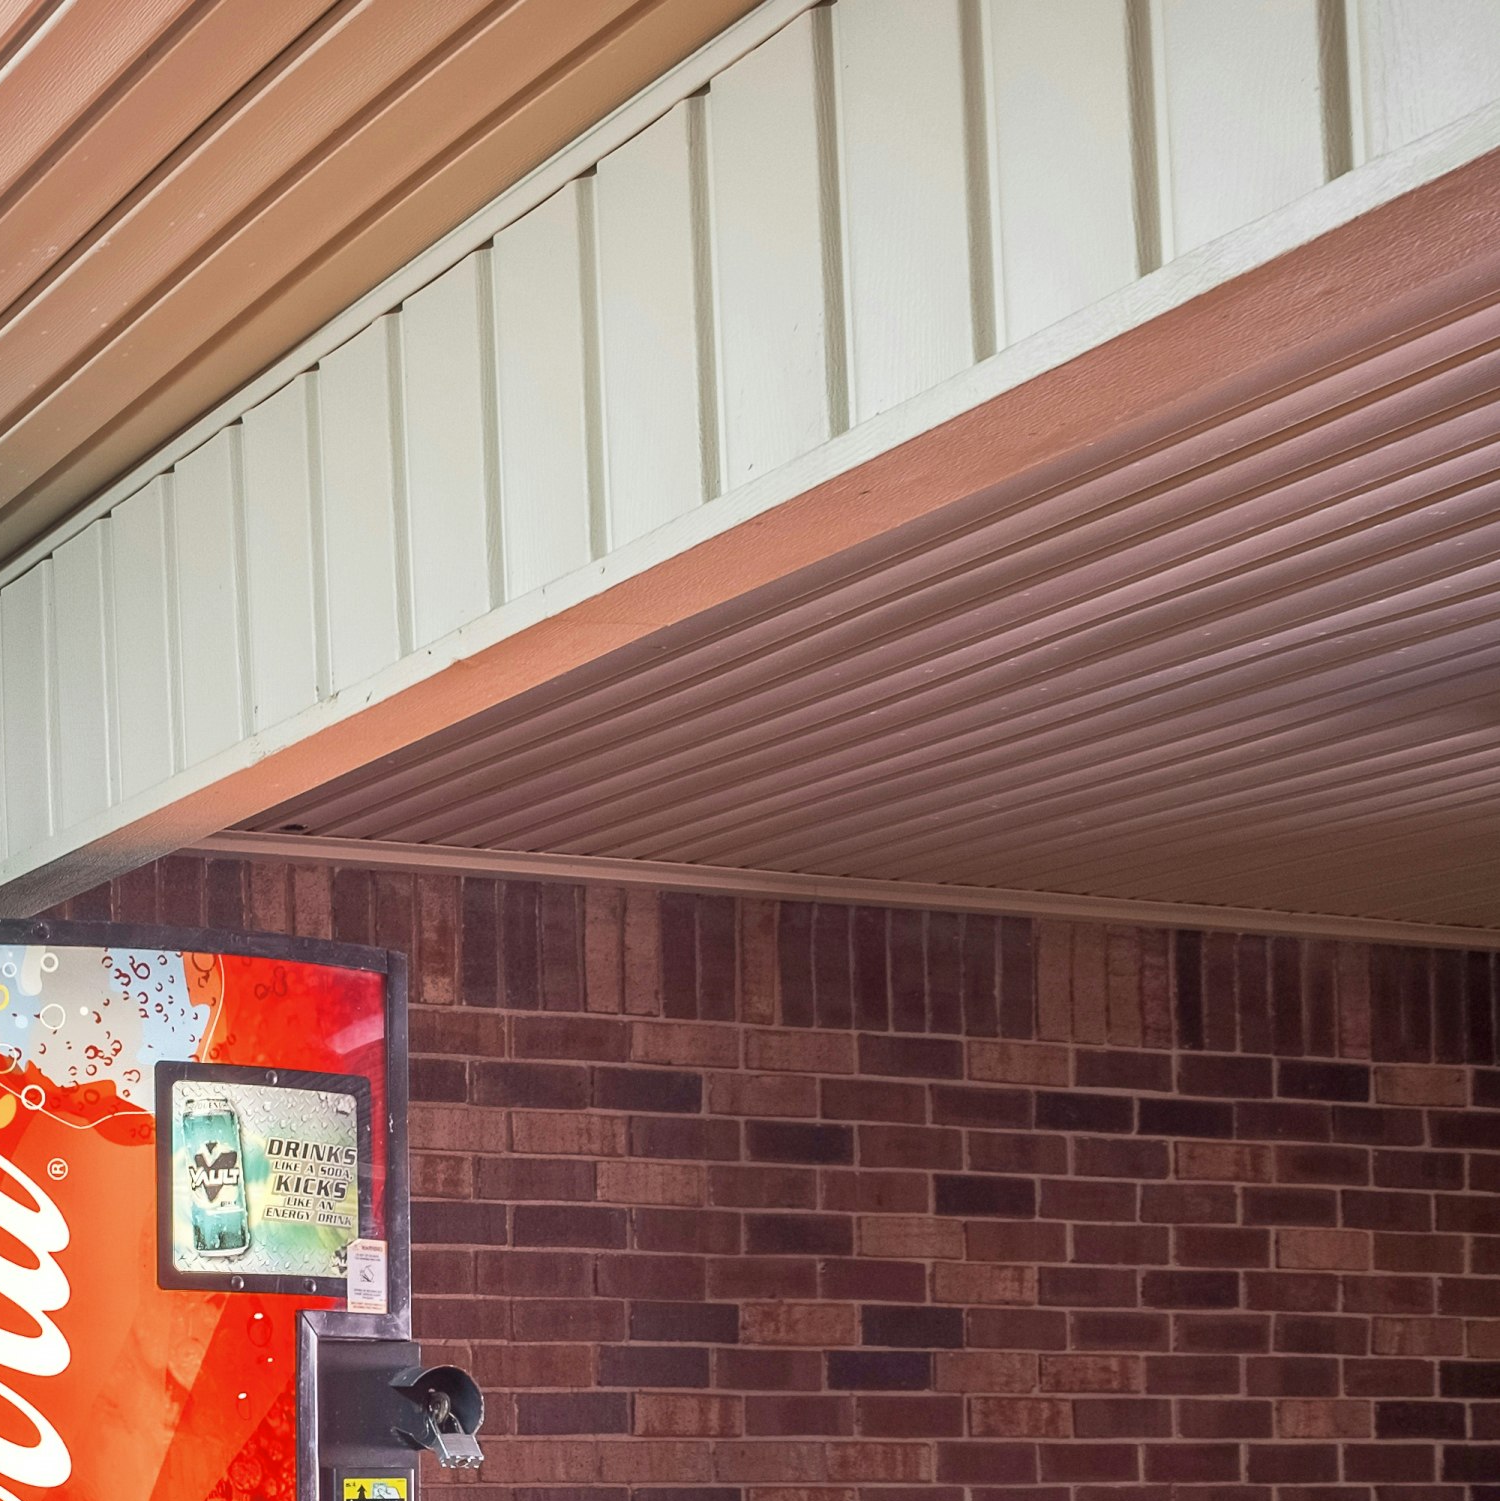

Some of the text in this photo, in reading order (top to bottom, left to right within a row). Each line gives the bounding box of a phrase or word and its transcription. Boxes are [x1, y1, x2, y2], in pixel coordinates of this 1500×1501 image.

[267, 1138, 357, 1166] DRINKS
[189, 1166, 240, 1191] VAULT
[274, 1160, 353, 1180] LIKE A SODA,
[276, 1174, 347, 1199] KICKS
[286, 1197, 335, 1211] LIKE AN
[266, 1207, 352, 1226] ENERGY DRINK
